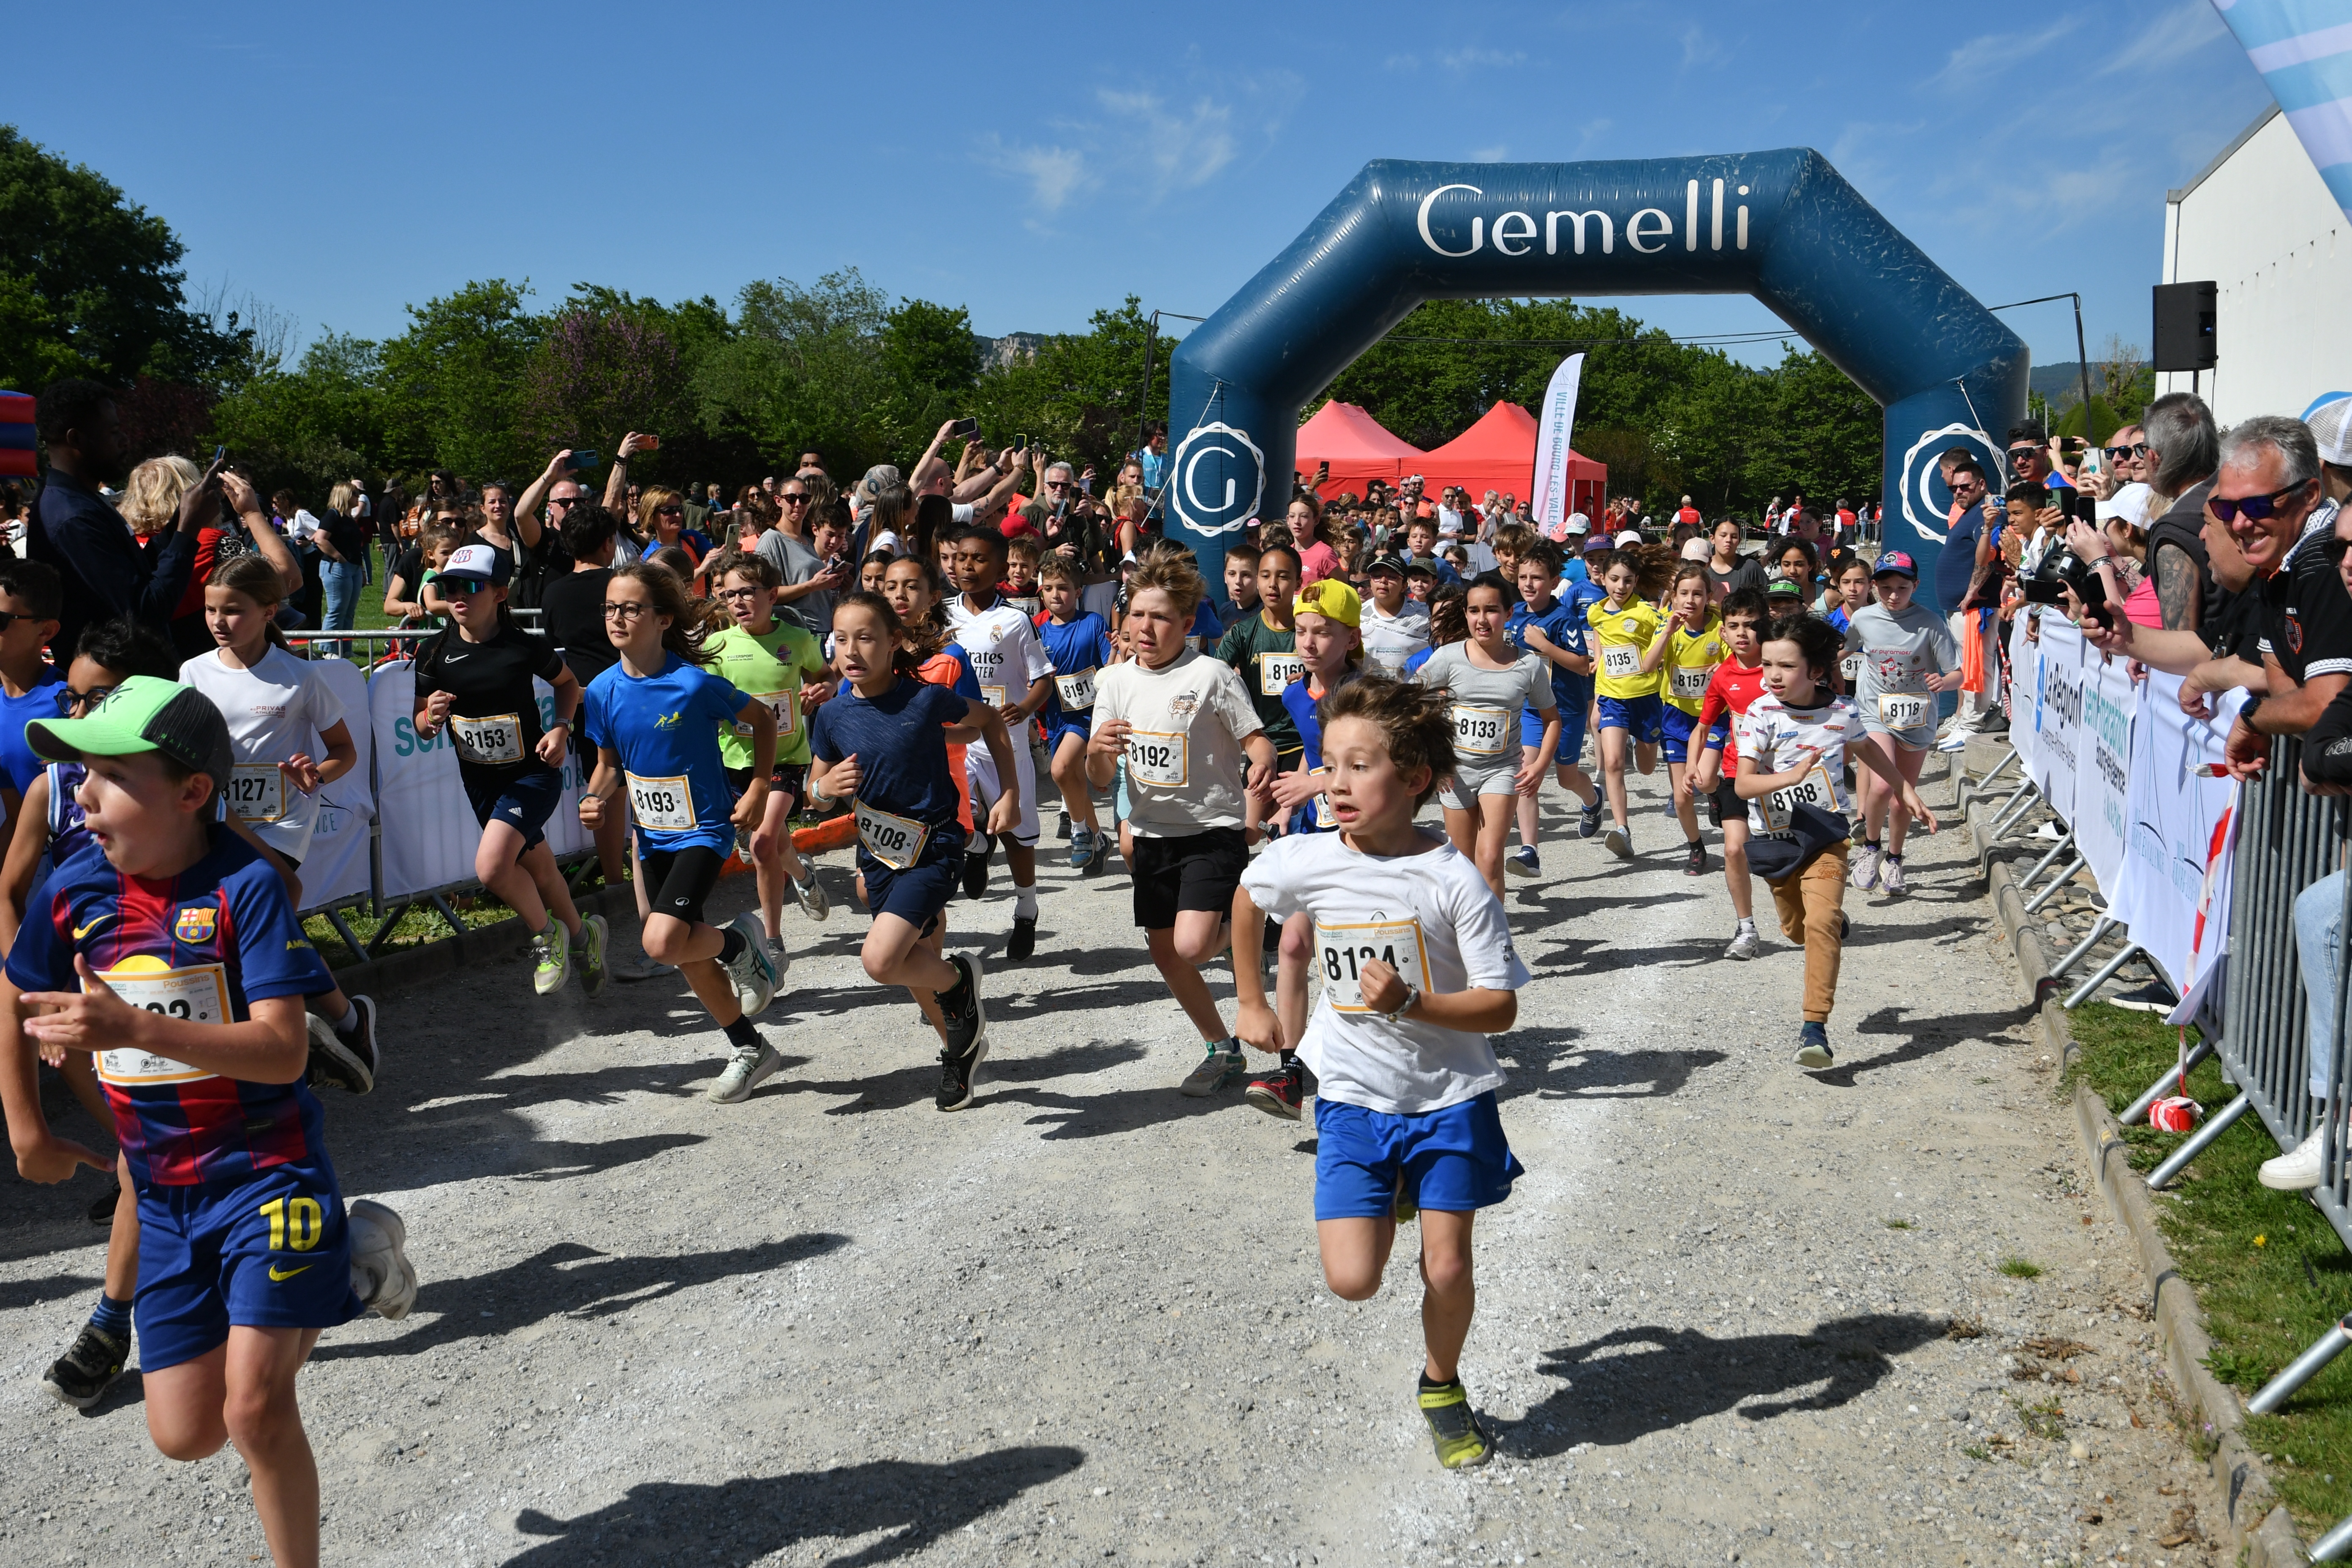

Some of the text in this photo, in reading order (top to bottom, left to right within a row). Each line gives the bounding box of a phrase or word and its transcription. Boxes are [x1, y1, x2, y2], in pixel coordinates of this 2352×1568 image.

[1417, 178, 1750, 257] Gemelli
[1554, 392, 1568, 420] VILLE
[1553, 422, 1563, 435] DE
[1185, 446, 1236, 512] G
[1772, 583, 1797, 591] FOX
[1606, 652, 1631, 667] 8135
[975, 666, 994, 678] TTER
[1678, 674, 1706, 687] 8157
[1064, 679, 1090, 698] 8191
[2044, 656, 2053, 707] La
[2053, 662, 2079, 730] Région
[1890, 702, 1920, 717] 8118
[1459, 718, 1496, 738] 8133
[465, 729, 506, 748] 8153
[1131, 741, 1170, 768] 8192
[636, 789, 675, 812] 8193
[1773, 783, 1818, 811] 8188
[860, 817, 906, 851] 8108
[1375, 927, 1410, 936] Poussins
[163, 974, 210, 989] Poussins
[260, 1196, 322, 1252] 10
